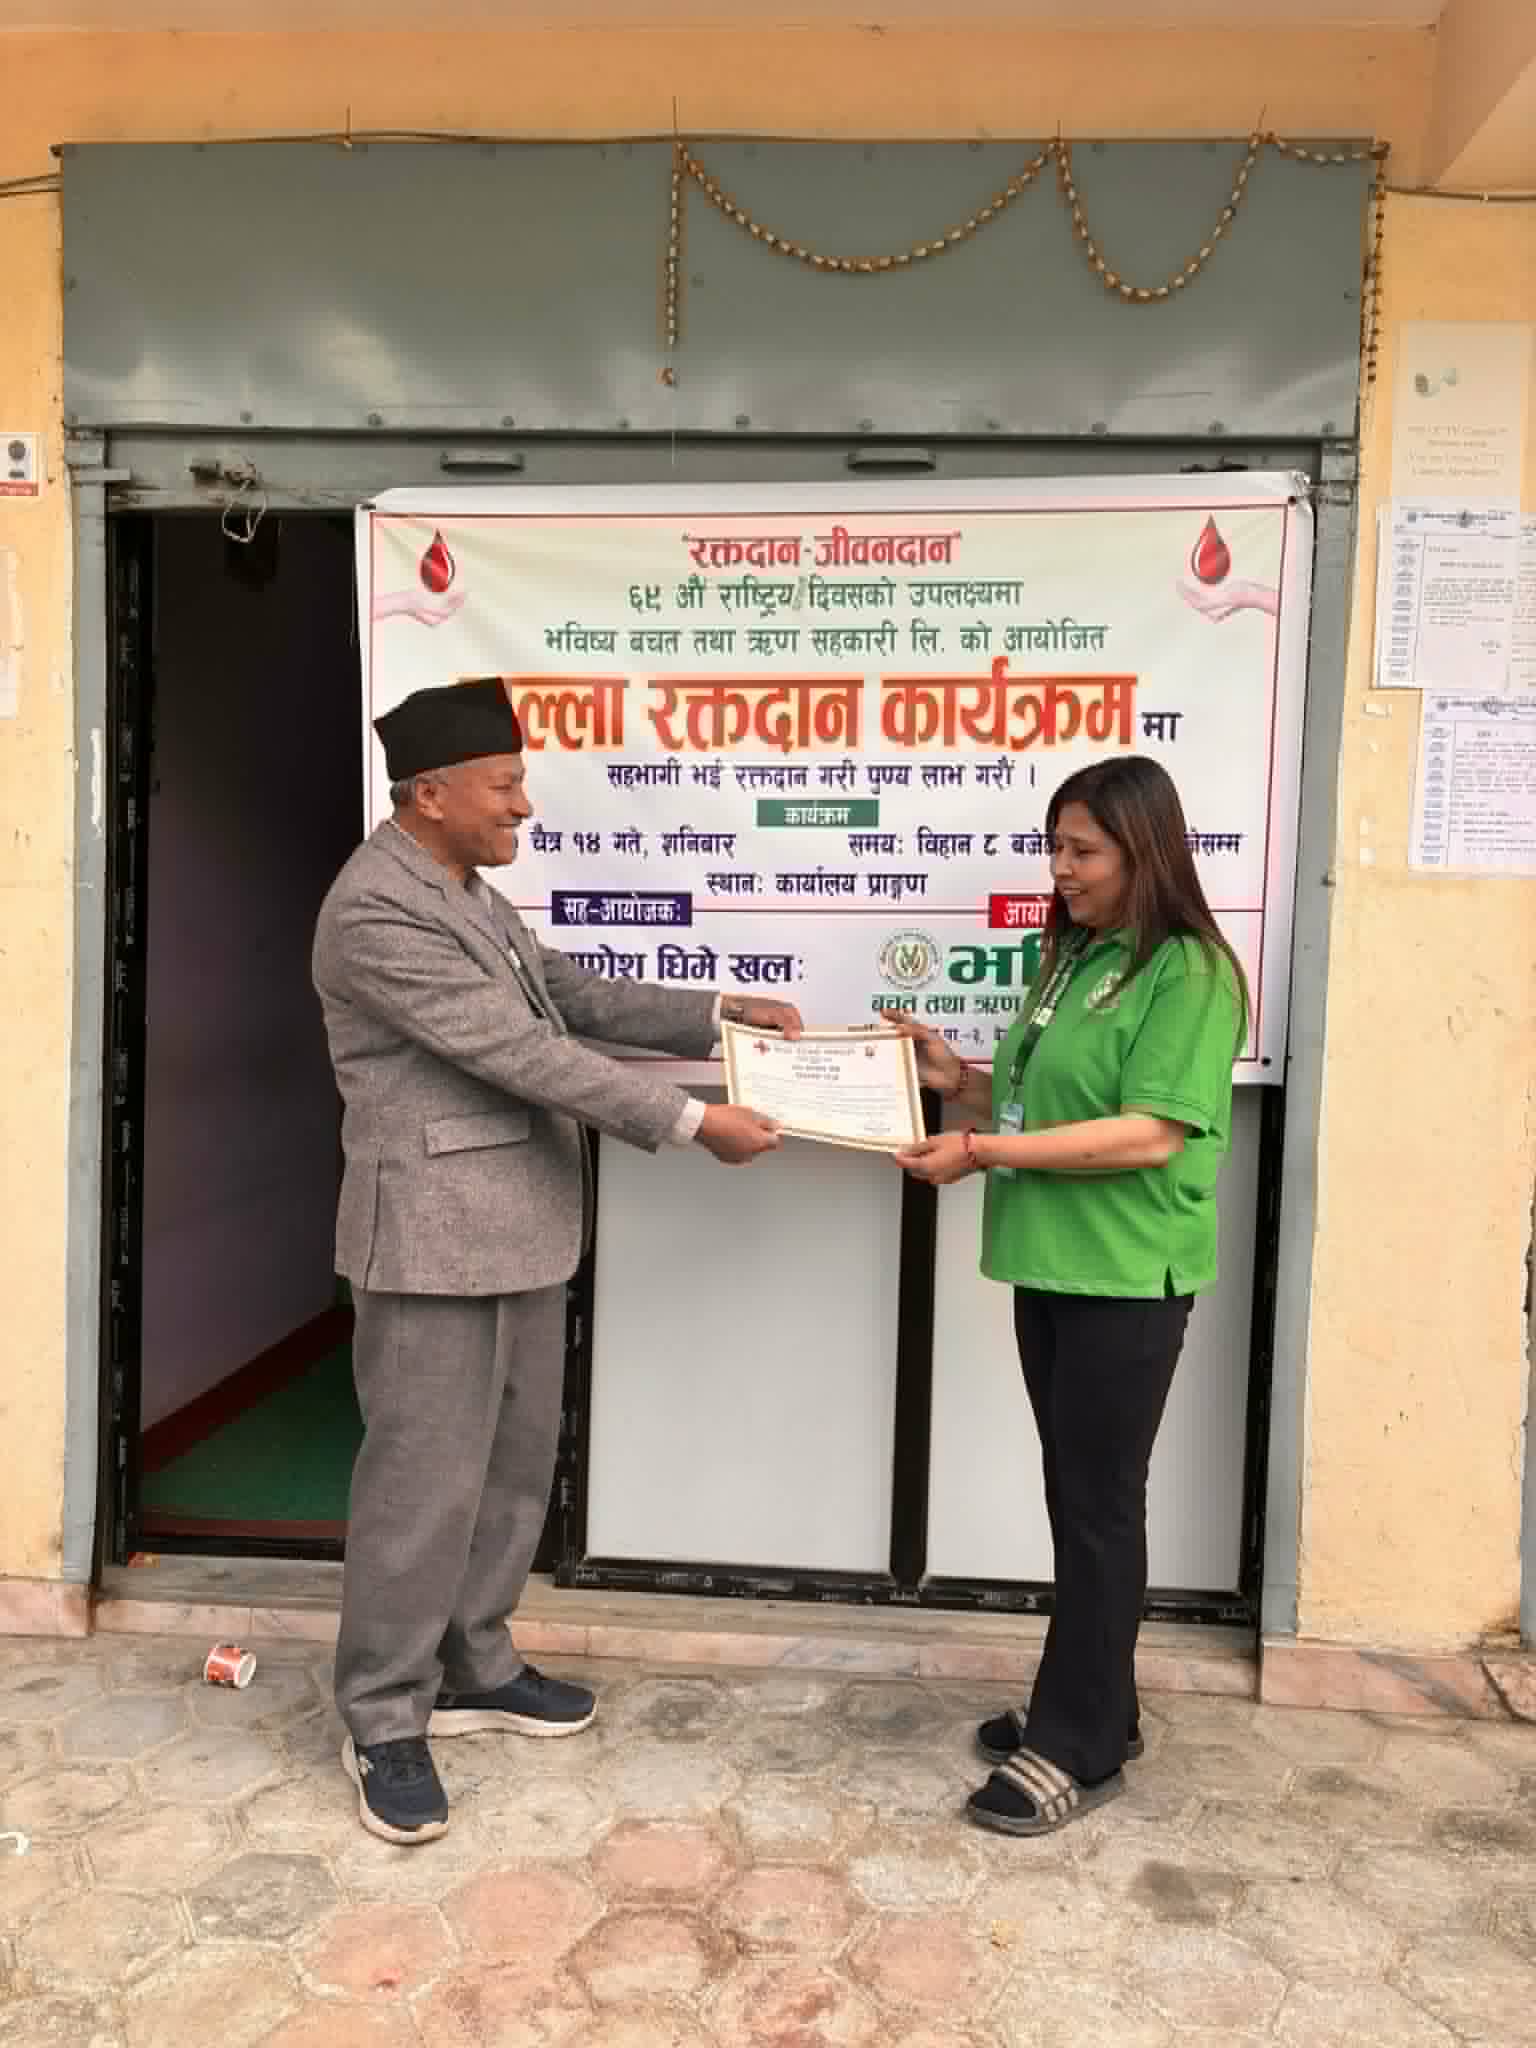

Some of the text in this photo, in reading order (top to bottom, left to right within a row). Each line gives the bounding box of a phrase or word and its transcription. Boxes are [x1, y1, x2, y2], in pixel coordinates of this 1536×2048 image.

[807, 573, 897, 612] दिवसको
[544, 622, 619, 654] भविष्य
[690, 630, 737, 656] तथा
[747, 630, 801, 656] ऋण
[808, 621, 898, 658] सहकारी
[960, 624, 993, 653] को
[1002, 620, 1111, 655] आयोजित
[648, 677, 864, 752] रक्तदान
[881, 655, 1137, 752] कार्यक्रम
[1141, 712, 1184, 743] मा
[607, 756, 683, 792] सहभागी
[735, 766, 810, 793] रक्तदान
[816, 757, 858, 792] गरी
[866, 764, 912, 795] पुण्य
[920, 764, 967, 790] लाभ
[783, 801, 851, 827] कार्यक्रम
[573, 831, 601, 857] १४
[775, 864, 857, 897] कार्यालय
[925, 994, 965, 1016] तथा
